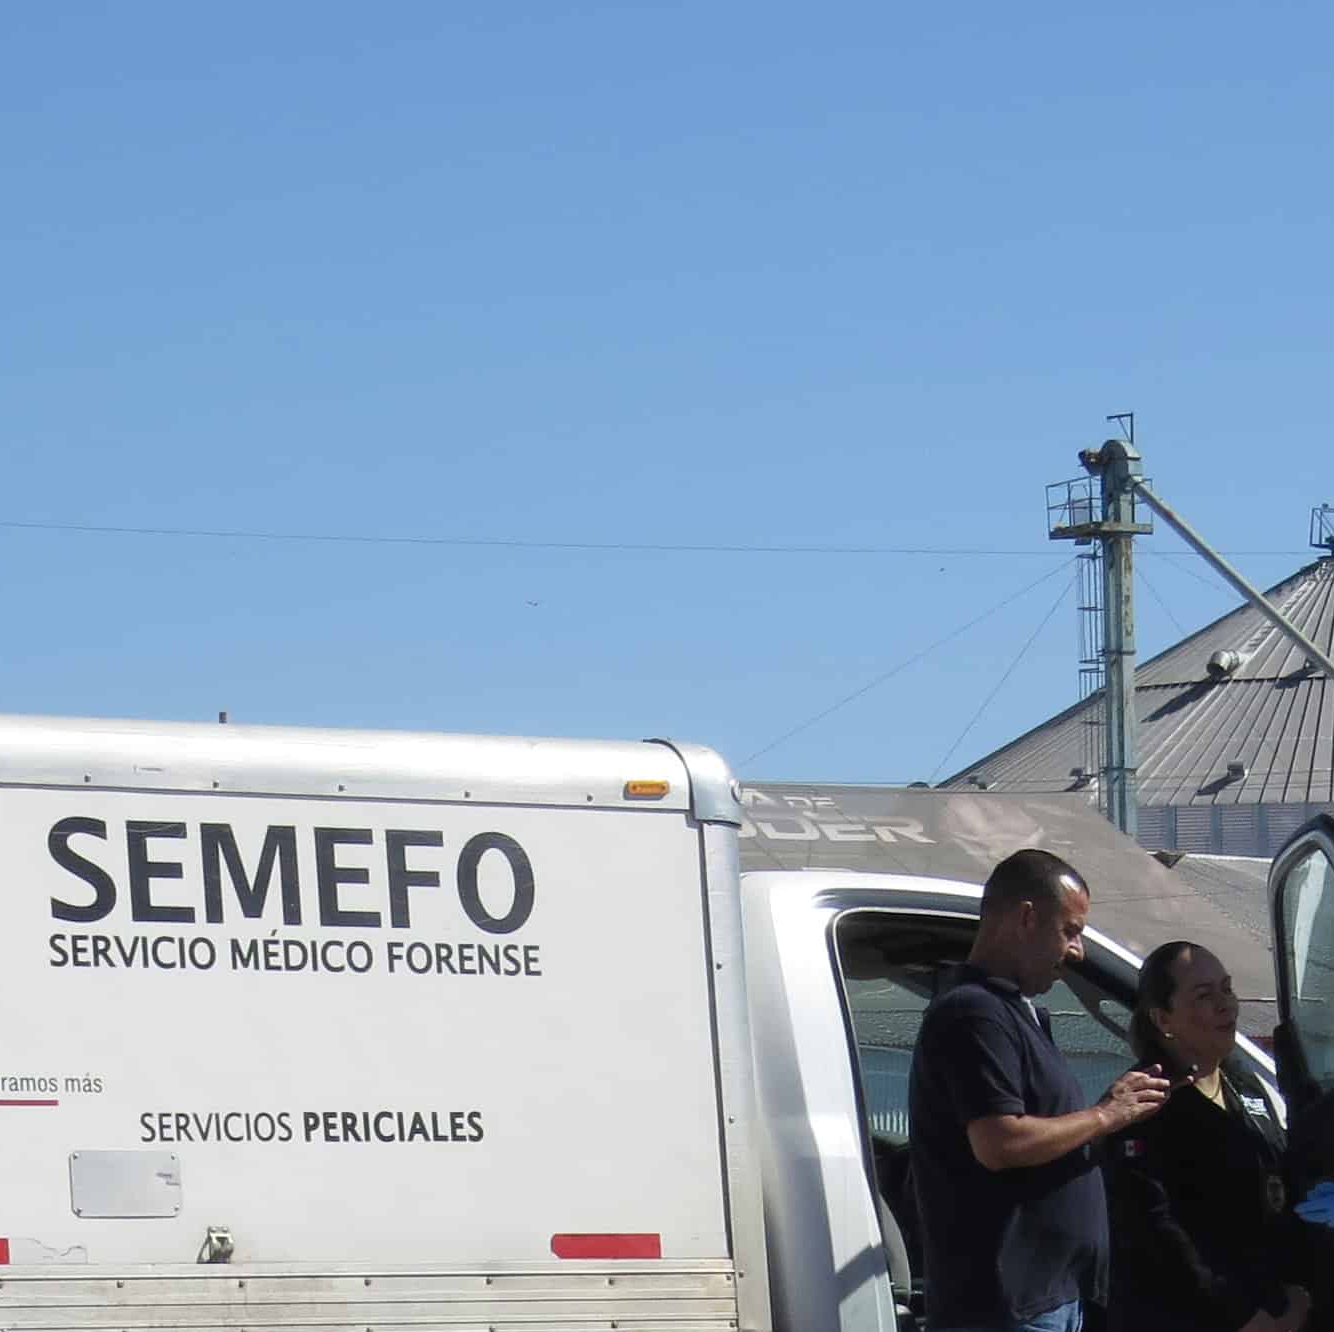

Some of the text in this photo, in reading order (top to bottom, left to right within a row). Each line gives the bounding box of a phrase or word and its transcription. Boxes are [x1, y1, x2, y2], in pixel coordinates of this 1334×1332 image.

[48, 816, 535, 934] SEMEFO
[49, 929, 542, 976] SERVICIO MÉDICO FORENSE
[64, 1072, 103, 1094] más
[140, 1111, 484, 1143] SERVICIOS PERICIALES
